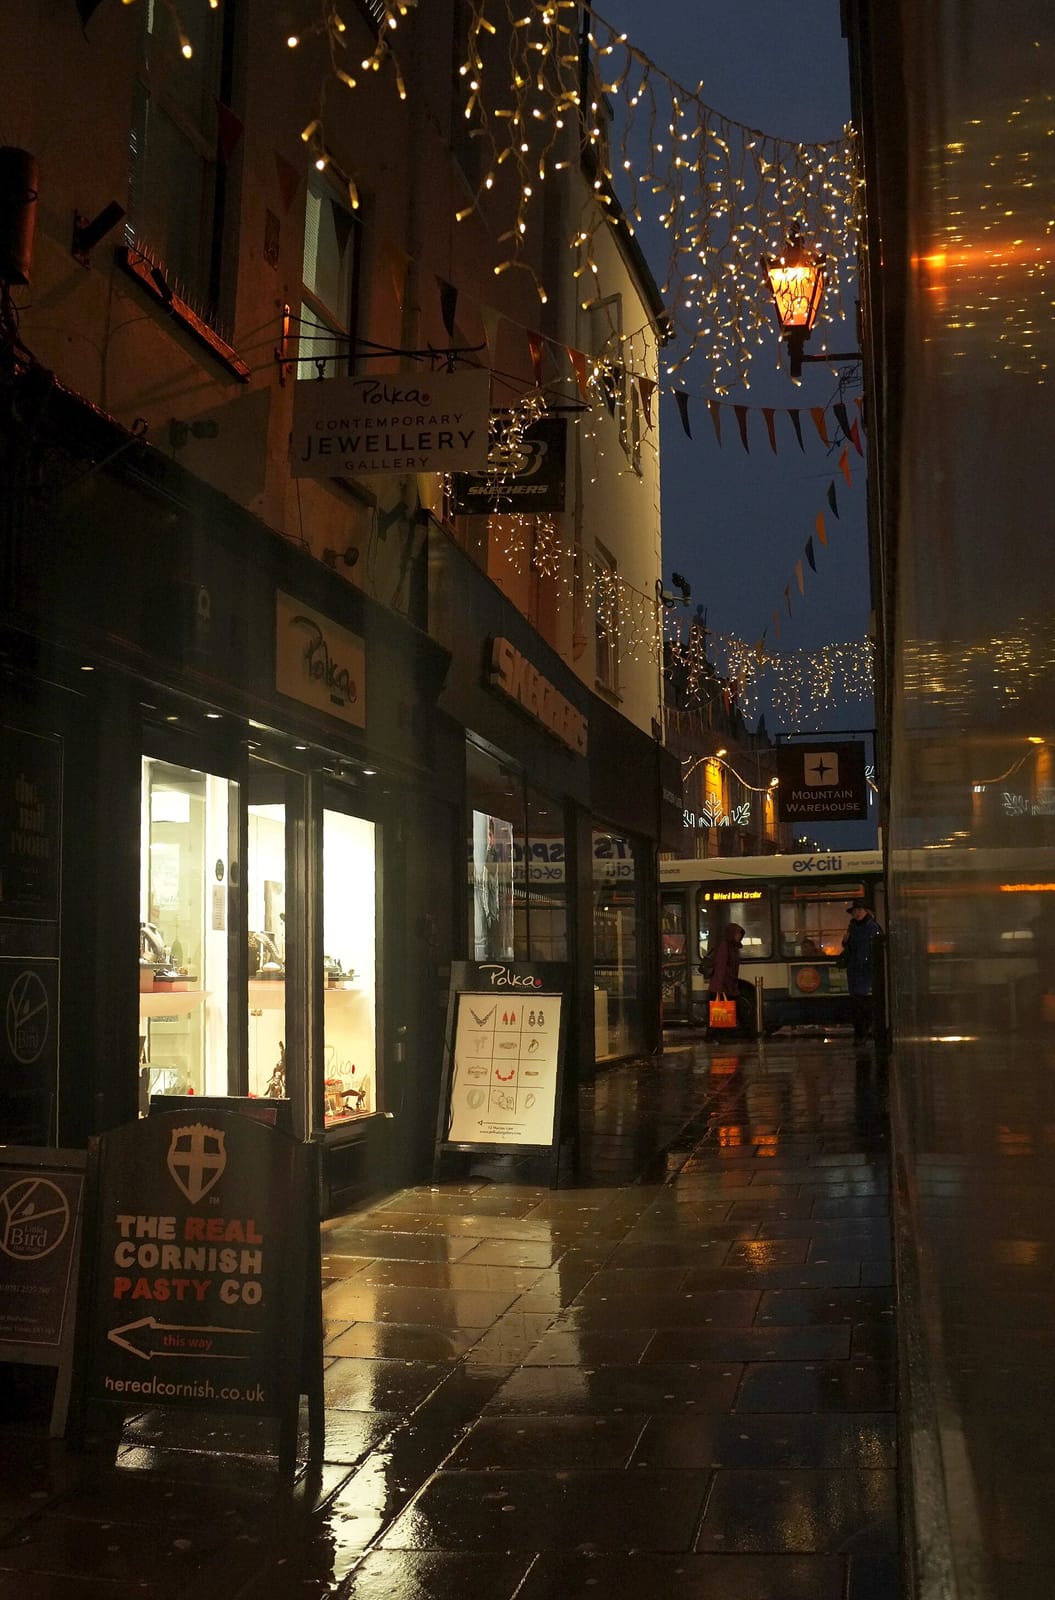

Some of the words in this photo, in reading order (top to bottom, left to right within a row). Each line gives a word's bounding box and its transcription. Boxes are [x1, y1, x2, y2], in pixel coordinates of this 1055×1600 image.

[354, 381, 432, 406] Polka
[315, 414, 463, 431] CONTEMPORARY
[302, 430, 475, 462] JEWELLERY
[345, 457, 429, 471] GALLERY
[467, 484, 549, 496] SKECHERS
[288, 615, 357, 704] Polka
[793, 855, 842, 872] ex-citi
[478, 964, 543, 989] Polka
[11, 1227, 48, 1248] Bird
[115, 1214, 177, 1240] THE
[184, 1216, 263, 1245] REAL
[114, 1241, 263, 1274] CORNISH
[113, 1276, 212, 1301] PASTY
[219, 1278, 263, 1305] CO
[162, 1334, 185, 1347] this
[188, 1337, 213, 1350] way
